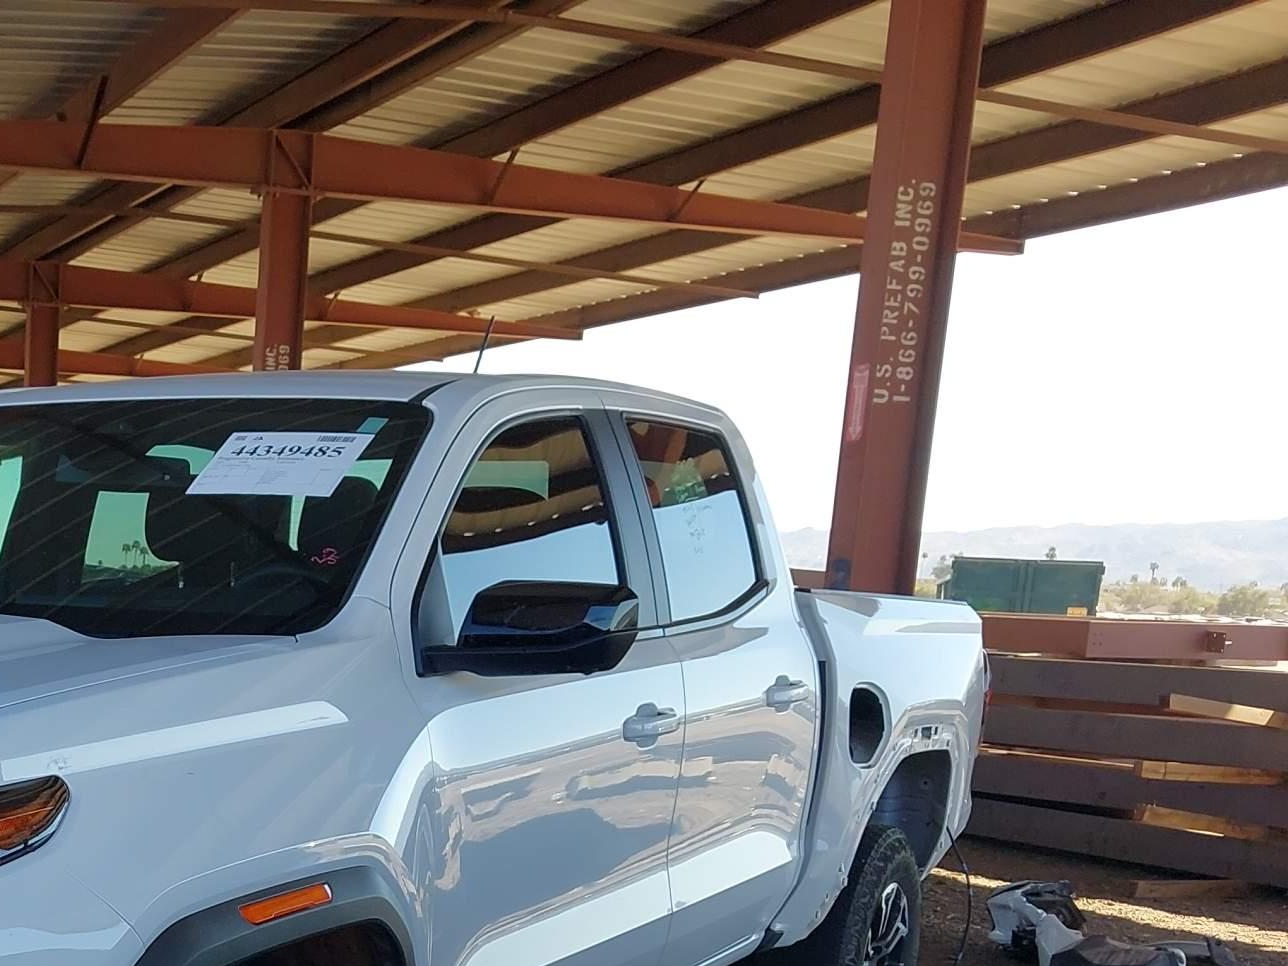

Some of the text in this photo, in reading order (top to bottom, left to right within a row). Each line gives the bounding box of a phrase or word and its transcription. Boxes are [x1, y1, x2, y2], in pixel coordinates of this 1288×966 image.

[873, 179, 916, 404] U.S. PREFAB INC.
[893, 182, 937, 403] 1-866-799-0969
[264, 344, 278, 370] INC.
[231, 445, 347, 458] 44349485
